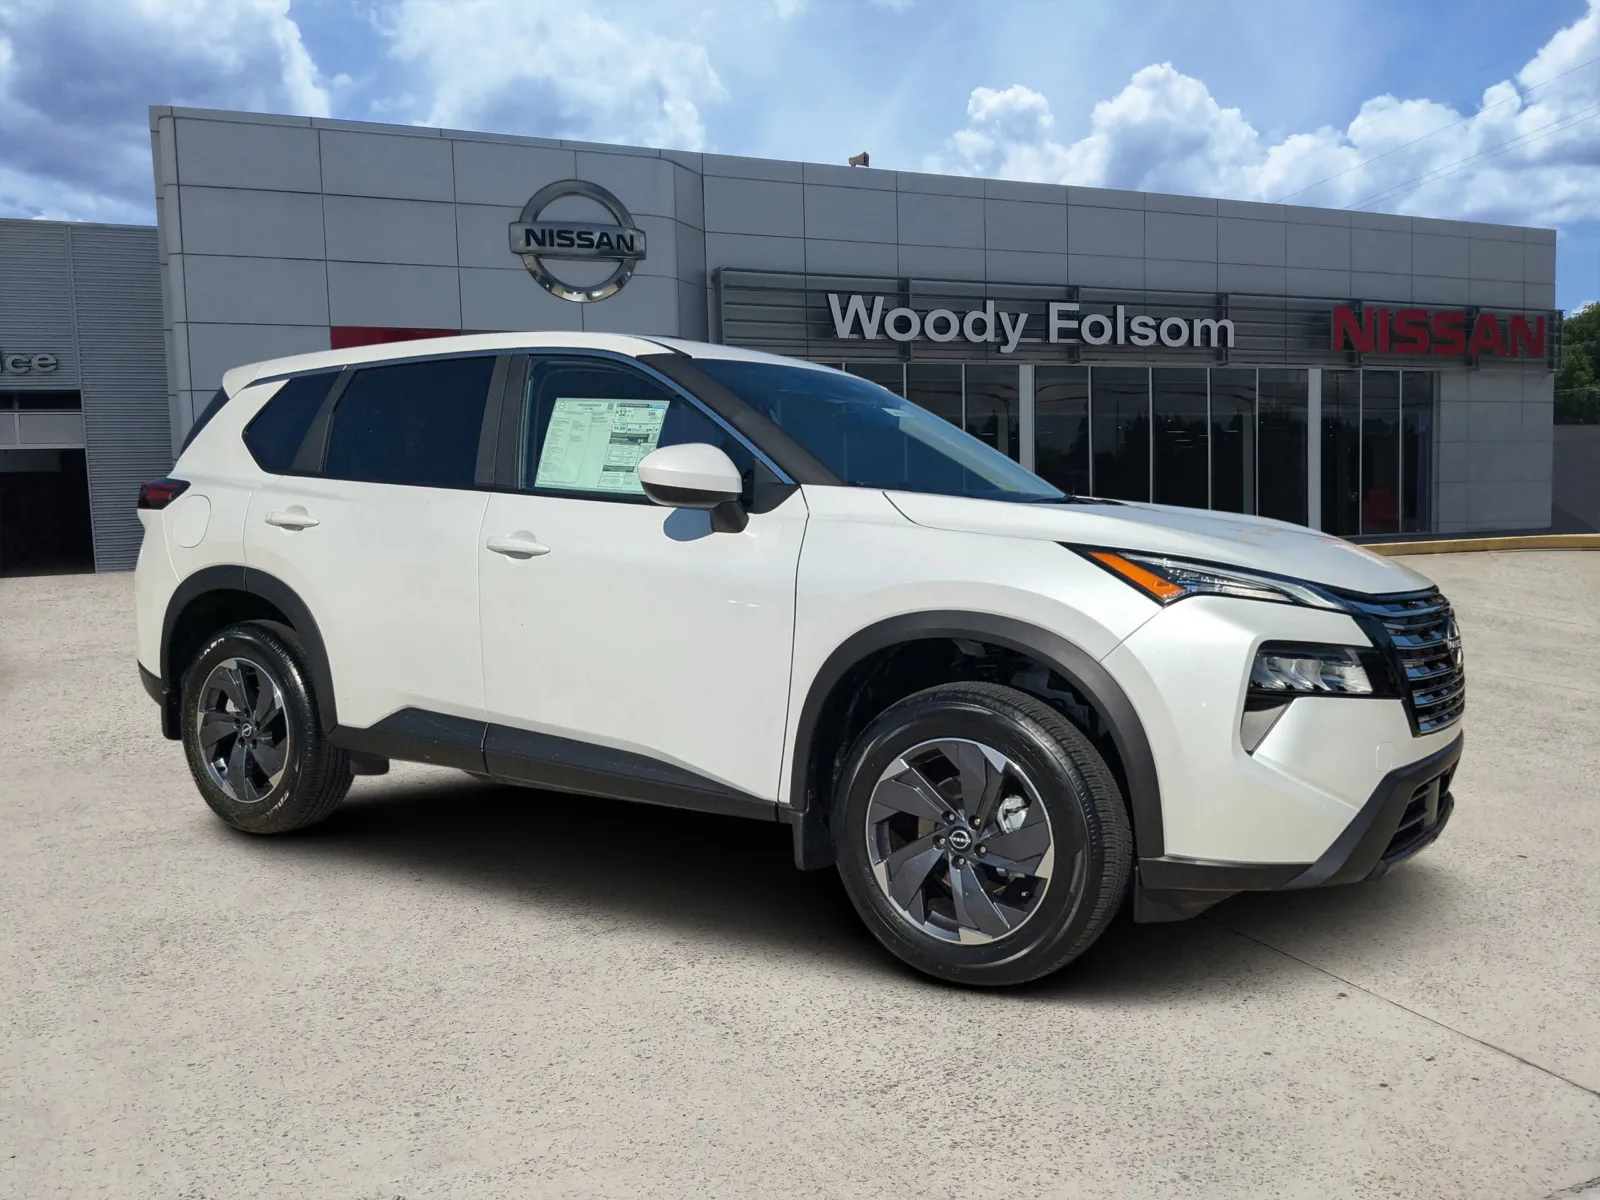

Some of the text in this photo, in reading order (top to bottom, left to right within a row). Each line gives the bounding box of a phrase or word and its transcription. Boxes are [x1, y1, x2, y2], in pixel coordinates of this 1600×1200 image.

[525, 228, 635, 252] NISSAN
[827, 293, 1235, 354] Woody Folsom
[1333, 305, 1545, 358] NISSAN
[0, 353, 57, 373] ce
